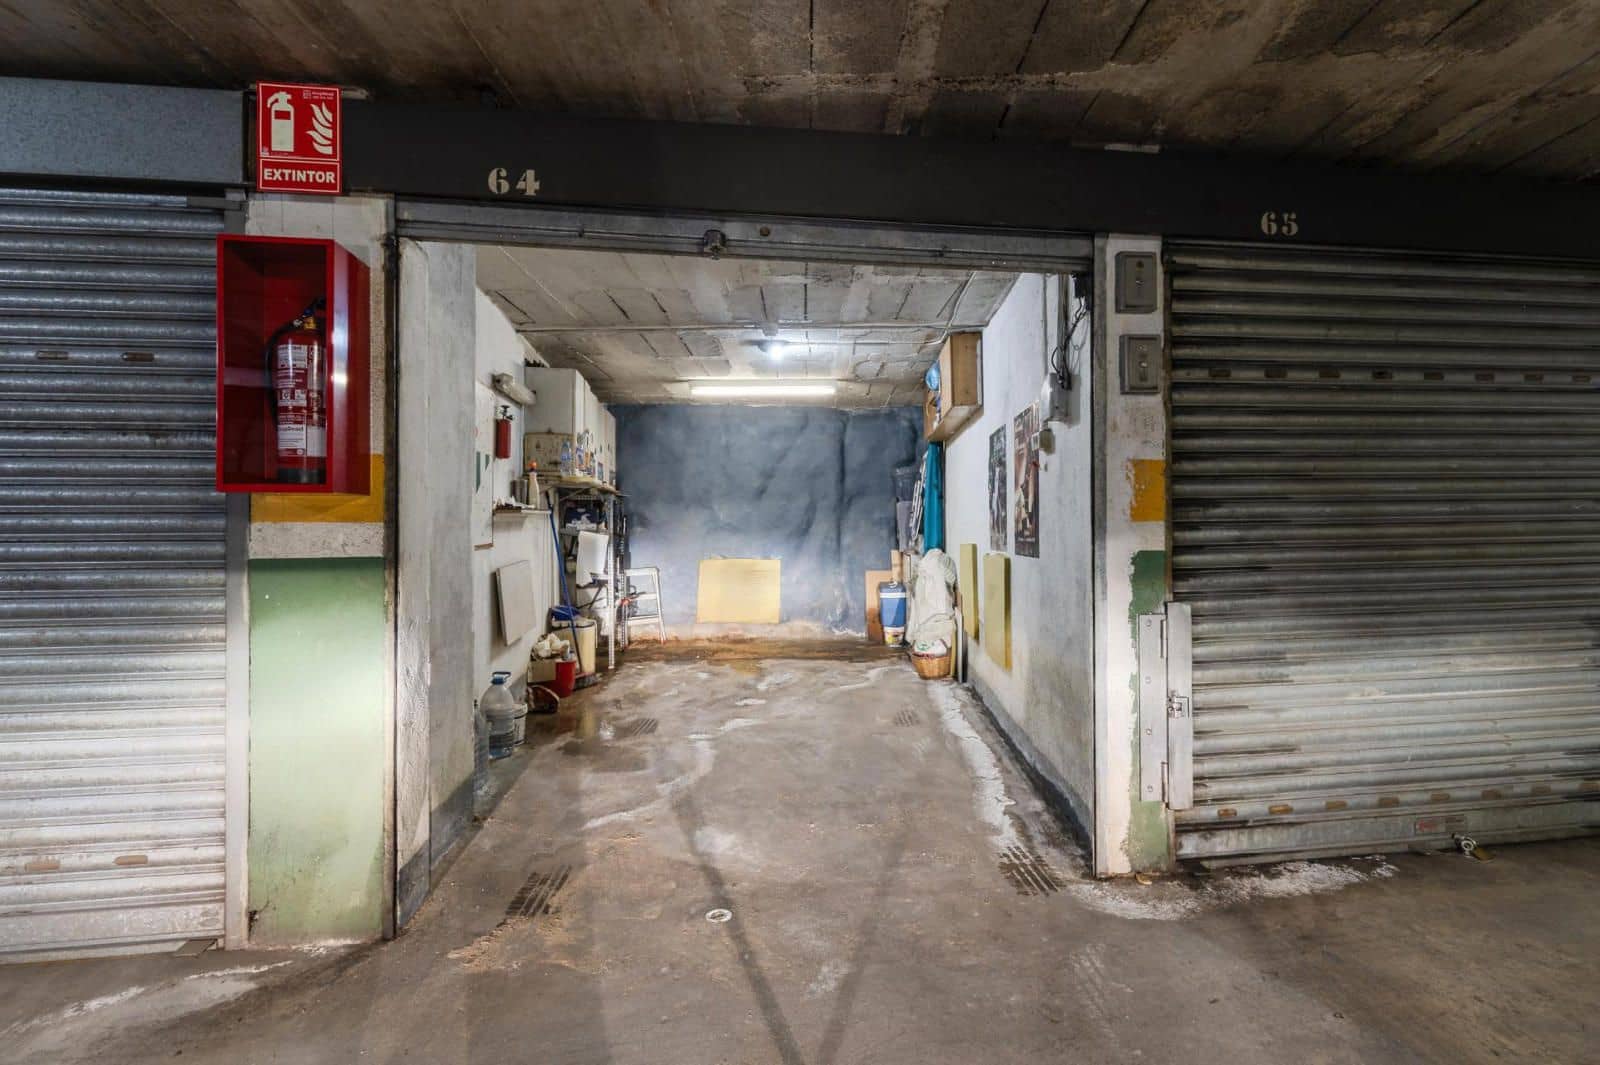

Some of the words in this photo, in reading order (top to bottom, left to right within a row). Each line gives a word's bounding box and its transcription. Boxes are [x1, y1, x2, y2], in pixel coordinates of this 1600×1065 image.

[263, 168, 336, 184] EXTINTOR
[488, 167, 541, 196] 64
[1261, 211, 1299, 236] 65
